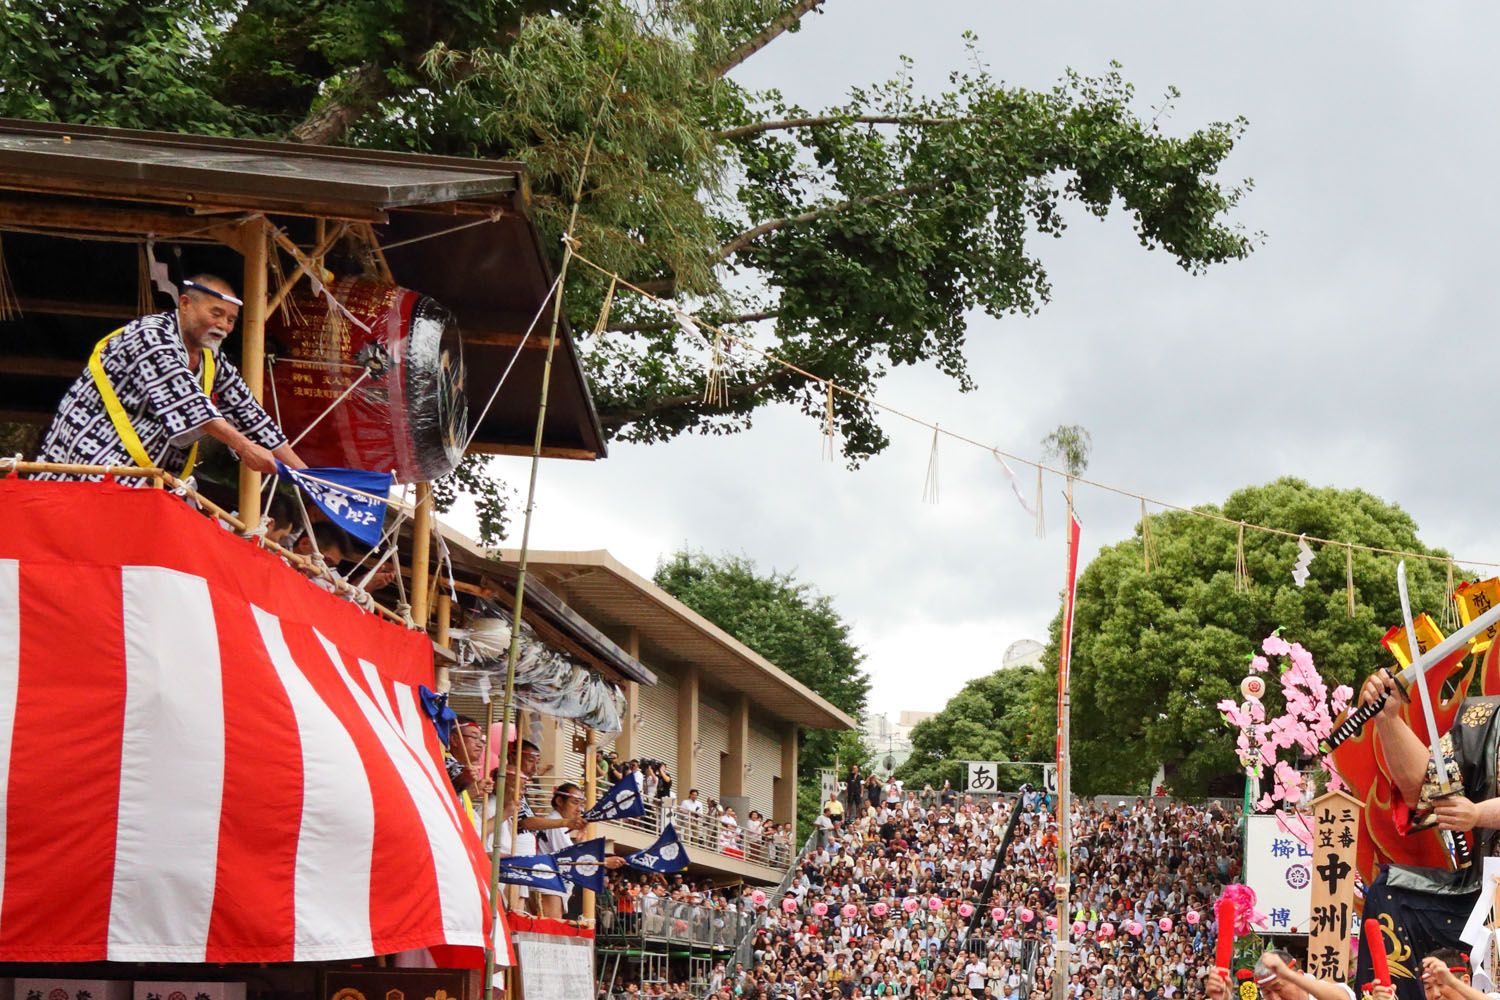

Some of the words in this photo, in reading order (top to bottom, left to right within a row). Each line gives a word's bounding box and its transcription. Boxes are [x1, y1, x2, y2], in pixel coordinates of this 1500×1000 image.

[971, 765, 996, 790] あ
[1318, 808, 1336, 848] 山笠
[1339, 808, 1356, 849] 三番
[1309, 852, 1352, 983] 中洲流
